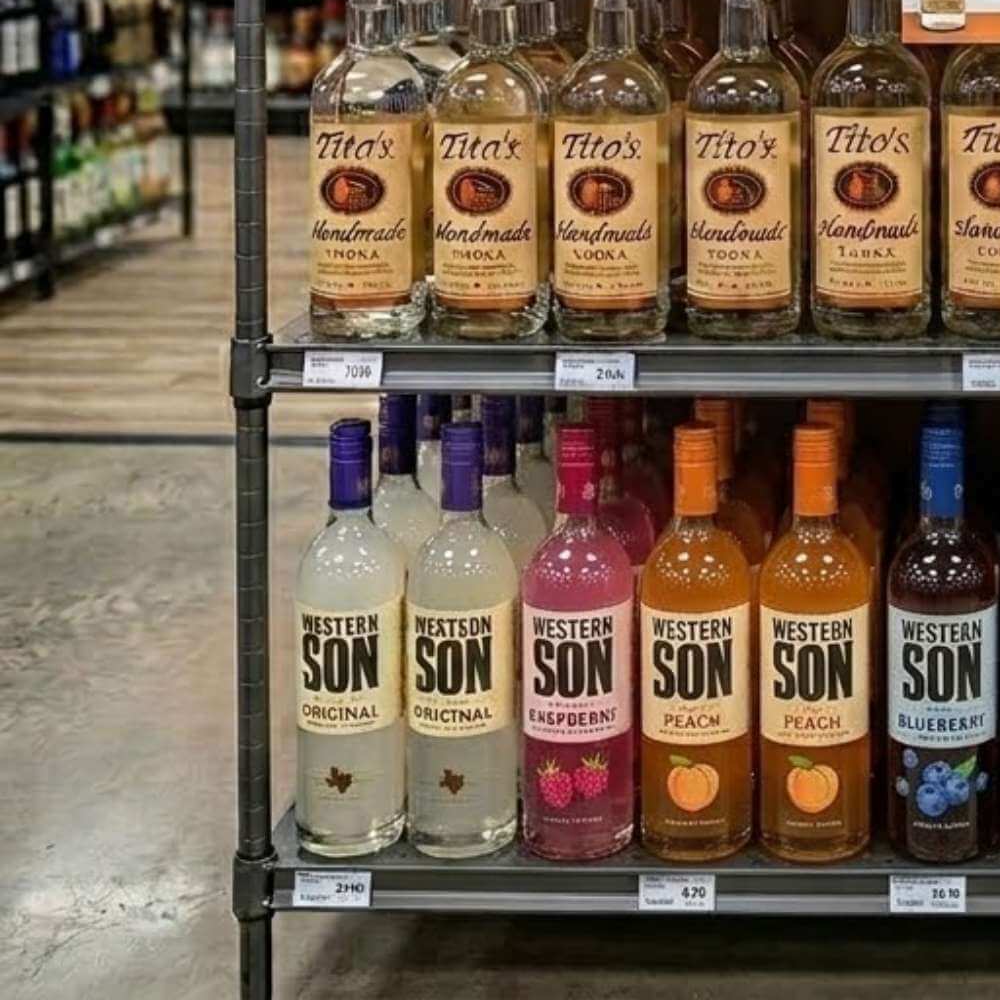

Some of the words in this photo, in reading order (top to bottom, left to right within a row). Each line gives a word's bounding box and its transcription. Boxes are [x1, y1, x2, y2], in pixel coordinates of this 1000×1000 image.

[301, 613, 379, 636] WESTERN
[532, 615, 613, 639] WESTERN
[652, 616, 732, 641] WESTERN
[901, 619, 982, 644] WESTERN
[301, 632, 380, 694] SON
[415, 635, 493, 696] SON
[533, 636, 613, 699] SON
[652, 638, 733, 701] SON
[772, 639, 854, 702] SON
[902, 640, 983, 703] SON
[784, 714, 841, 731] PEACH
